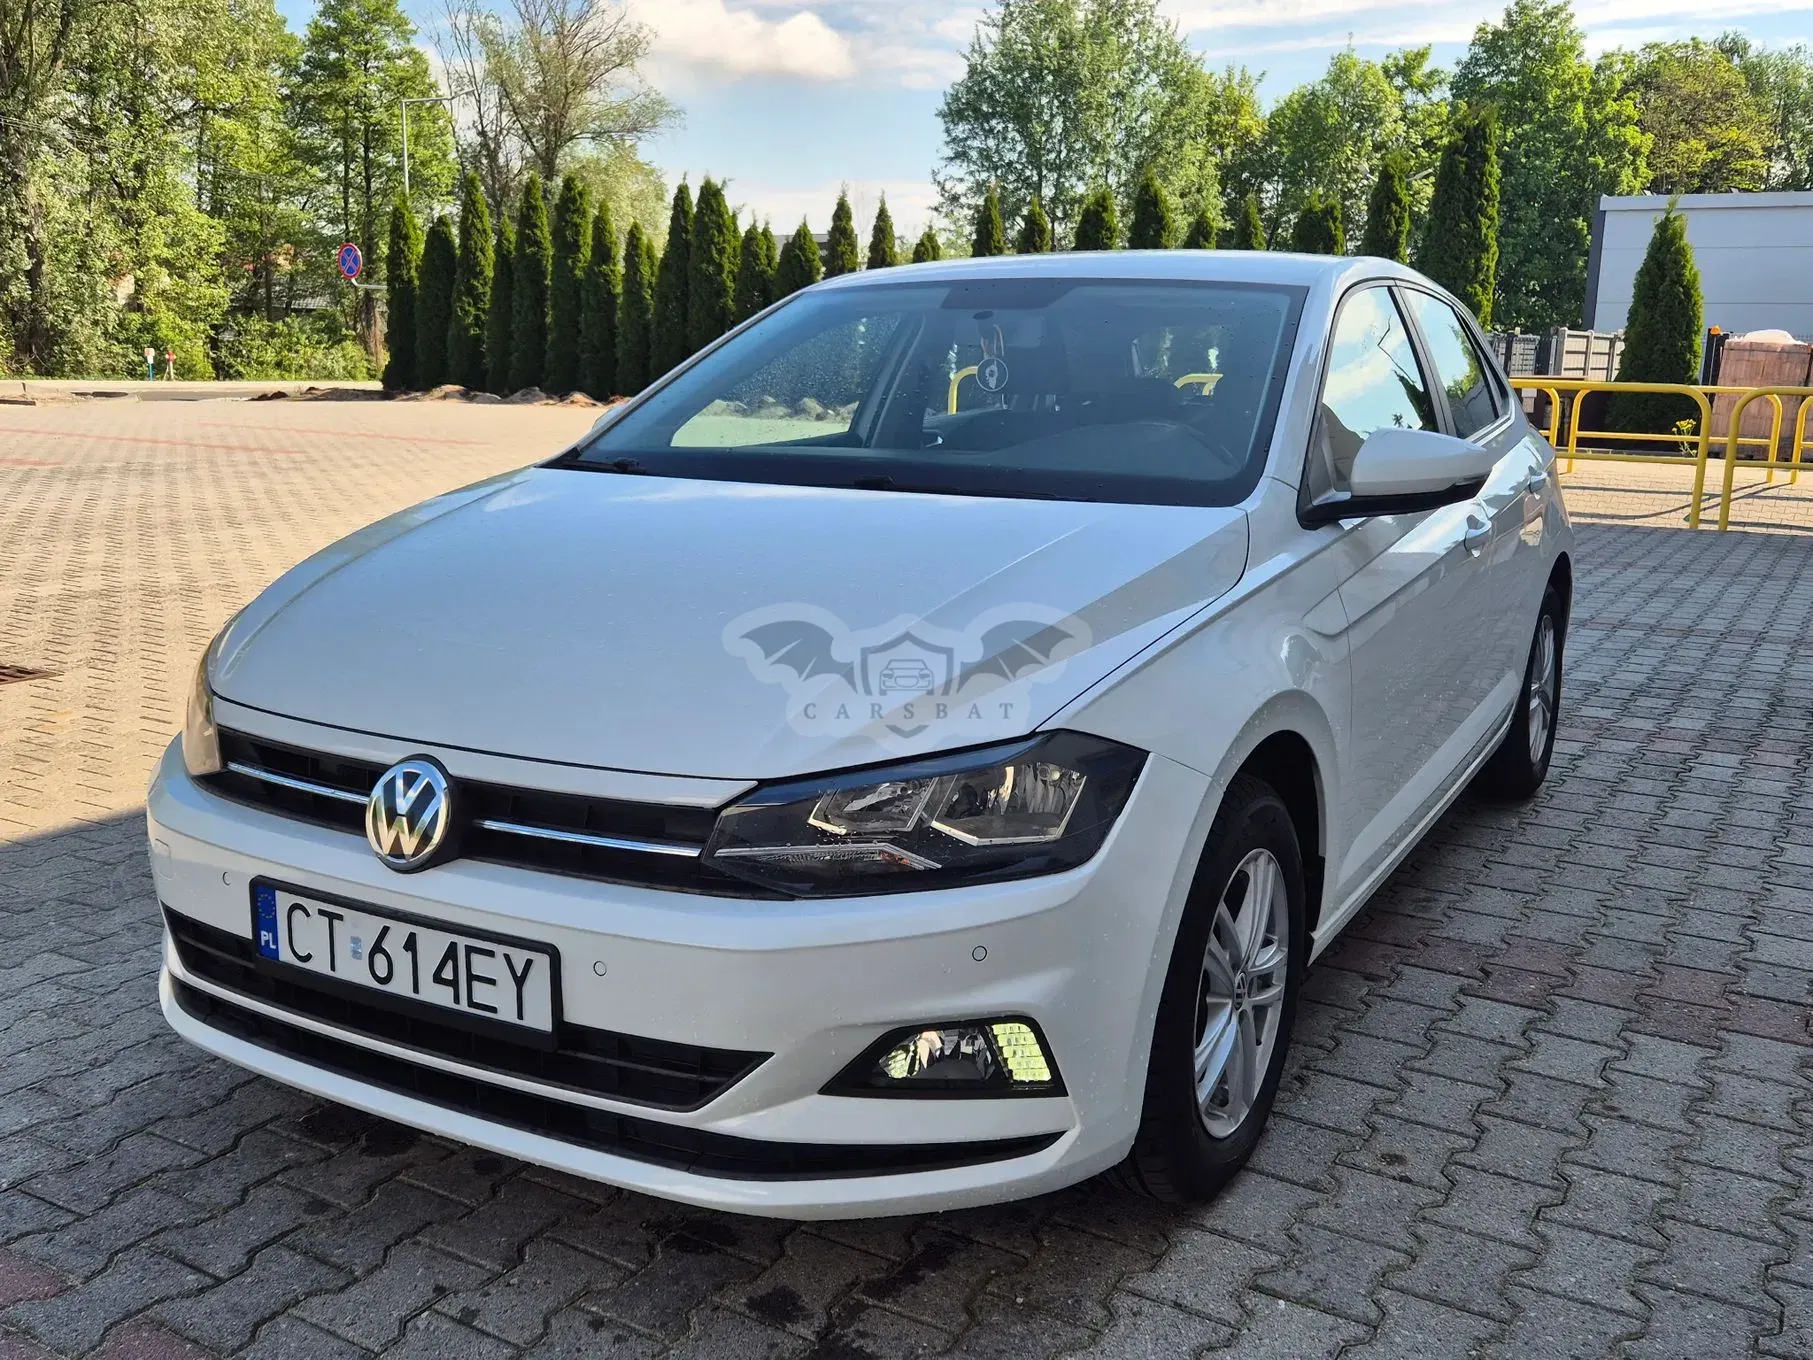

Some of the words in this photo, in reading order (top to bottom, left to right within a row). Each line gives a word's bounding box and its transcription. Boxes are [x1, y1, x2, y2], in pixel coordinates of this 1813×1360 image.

[260, 931, 277, 950] PL
[287, 902, 344, 972] CT
[367, 925, 534, 1021] 614EY
